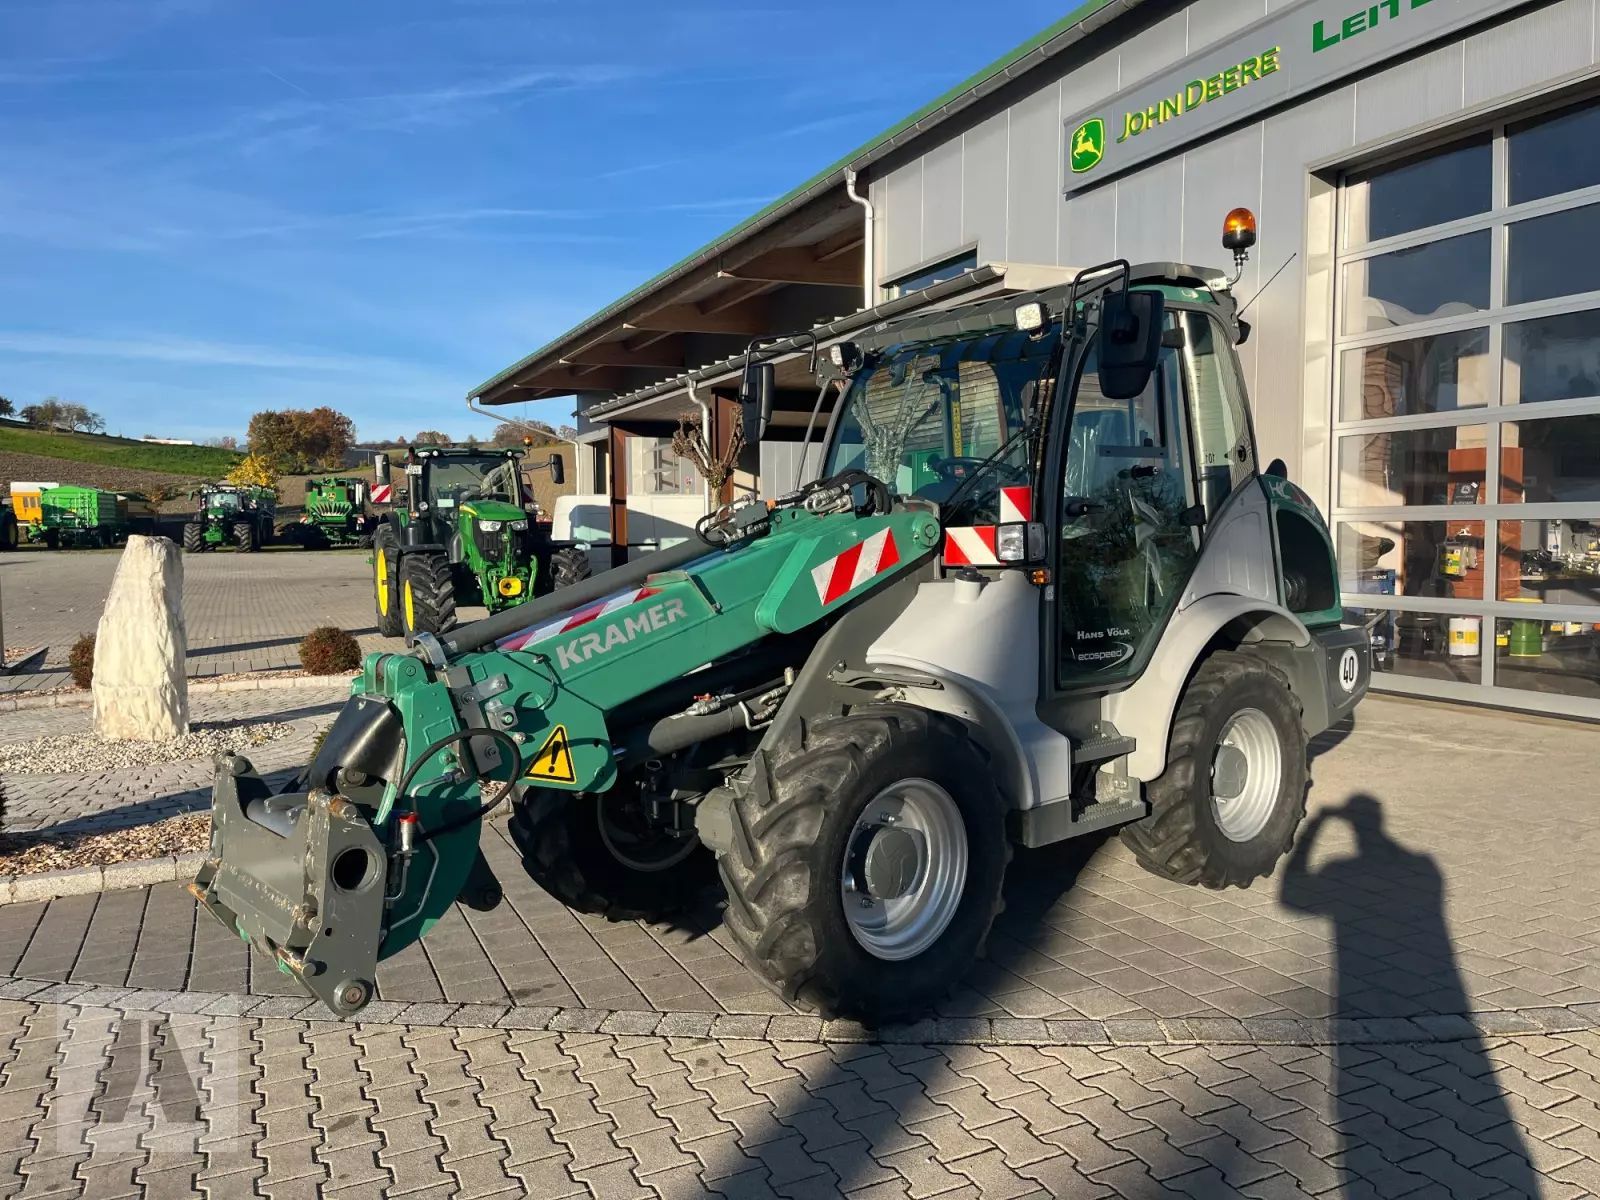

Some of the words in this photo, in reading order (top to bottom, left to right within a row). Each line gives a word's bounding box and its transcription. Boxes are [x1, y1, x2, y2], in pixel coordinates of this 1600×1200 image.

[1312, 0, 1434, 53] LEIT
[1116, 92, 1182, 144] JOHN
[1185, 46, 1280, 112] DEERE
[556, 598, 688, 671] KRAMER
[1077, 630, 1105, 640] HANS
[1106, 627, 1131, 637] VÖLK
[1077, 648, 1122, 661] ecospeed
[1343, 656, 1355, 684] 40
